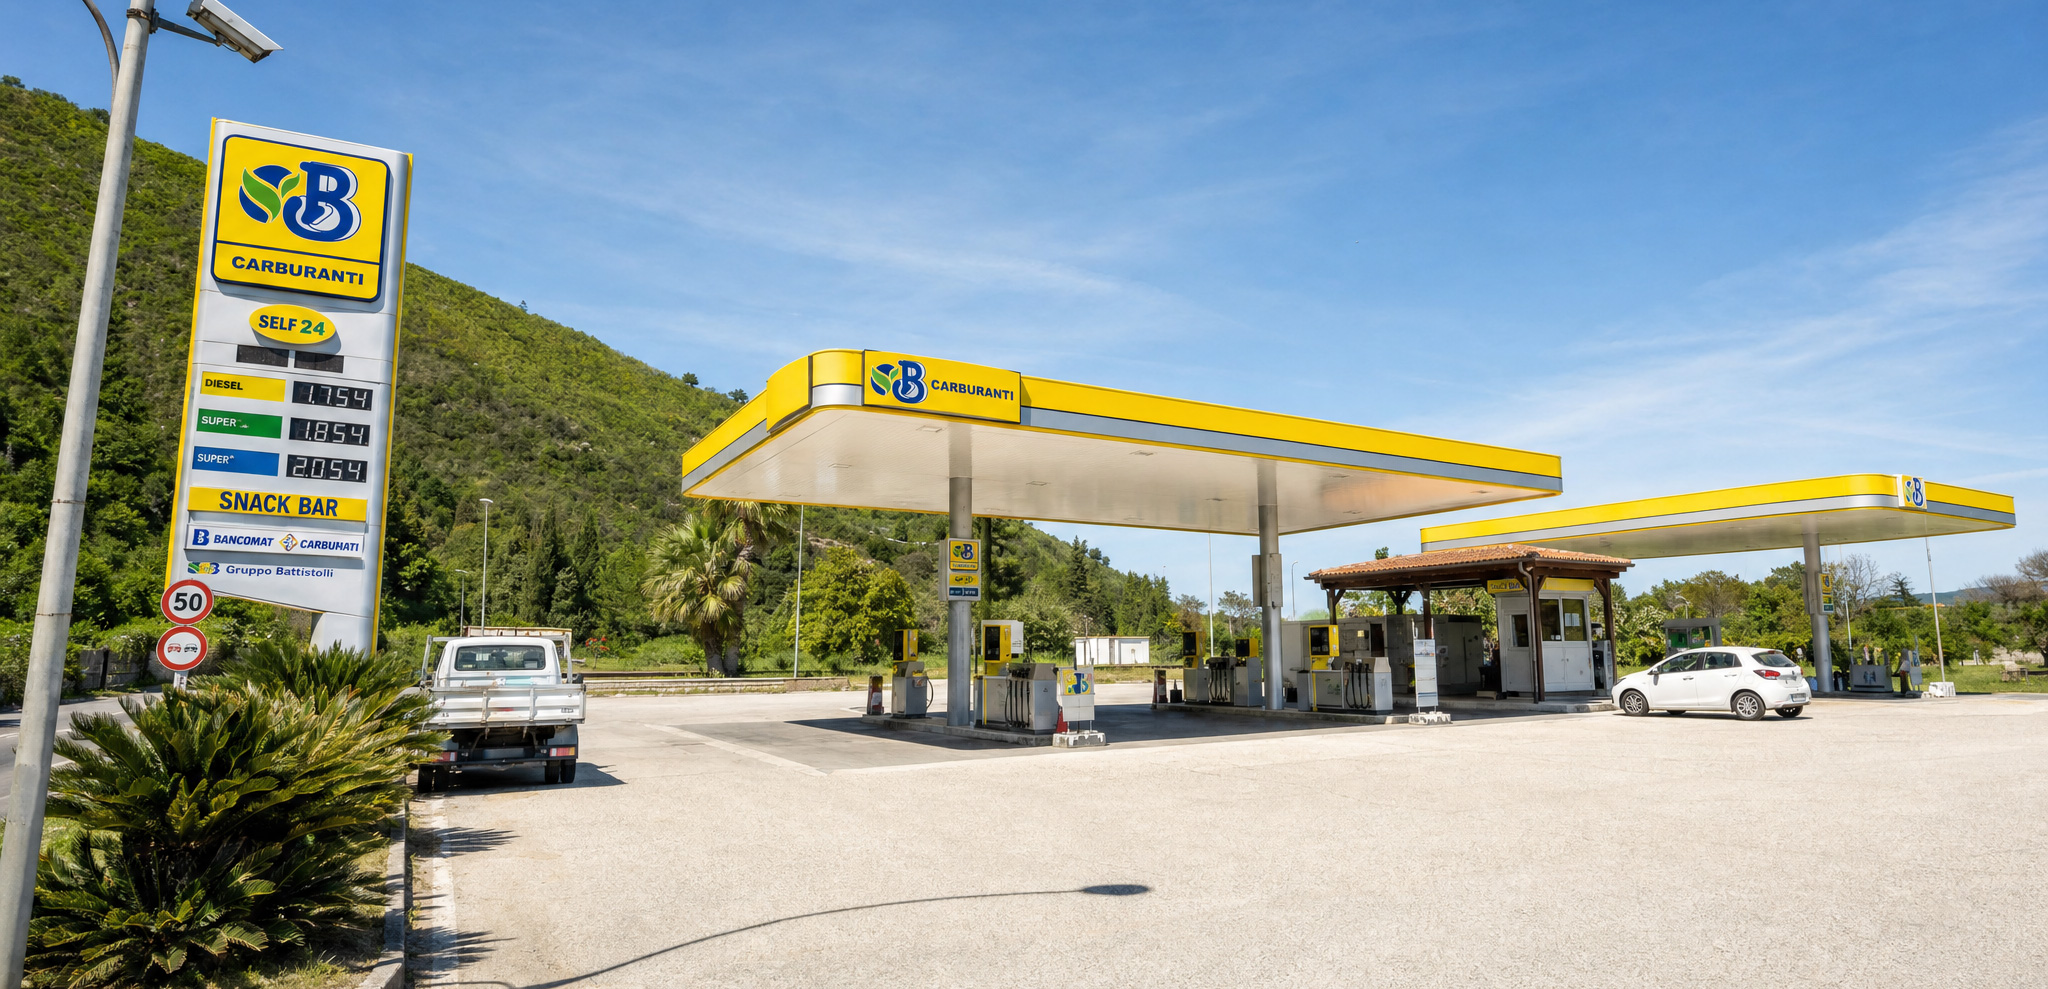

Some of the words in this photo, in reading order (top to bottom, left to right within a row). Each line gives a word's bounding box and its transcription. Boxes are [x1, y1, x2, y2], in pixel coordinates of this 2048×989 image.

[232, 256, 364, 285] CARBURANTI
[258, 315, 297, 331] SELF
[300, 320, 325, 336] 24
[205, 379, 243, 390] DIESEL
[931, 380, 1014, 401] CARBURANTI
[201, 416, 237, 427] SUPER
[305, 421, 364, 444] 1.854
[292, 457, 361, 480] 2.054
[219, 491, 291, 513] SNACK
[298, 497, 338, 516] BAR
[213, 535, 274, 547] BANCOMAT
[226, 565, 272, 577] Gruppo
[276, 567, 334, 578] Battistolli
[173, 593, 203, 612] 50
